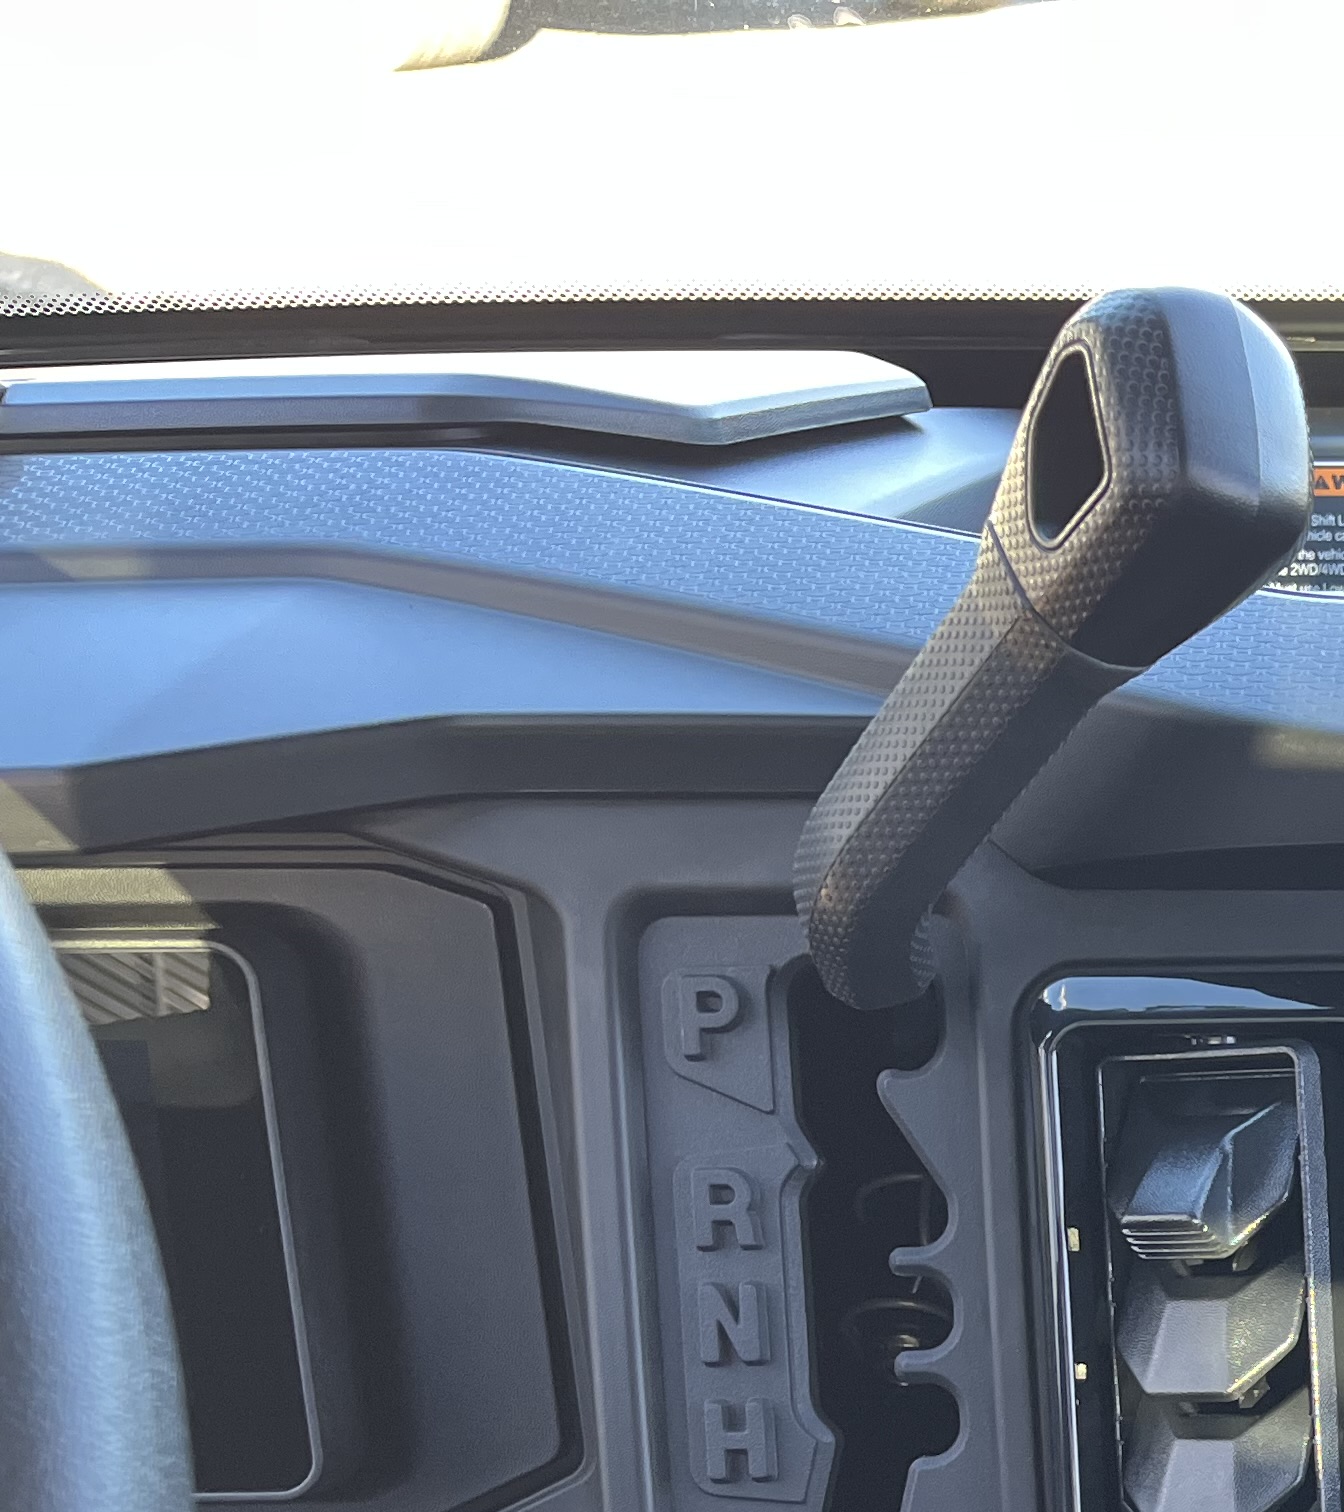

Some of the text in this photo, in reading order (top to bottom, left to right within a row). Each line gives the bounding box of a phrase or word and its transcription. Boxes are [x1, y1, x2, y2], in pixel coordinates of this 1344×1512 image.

[1311, 513, 1336, 527] Shift
[681, 974, 741, 1061] P
[691, 1167, 764, 1250] R
[700, 1281, 770, 1366] N
[705, 1399, 778, 1483] H
